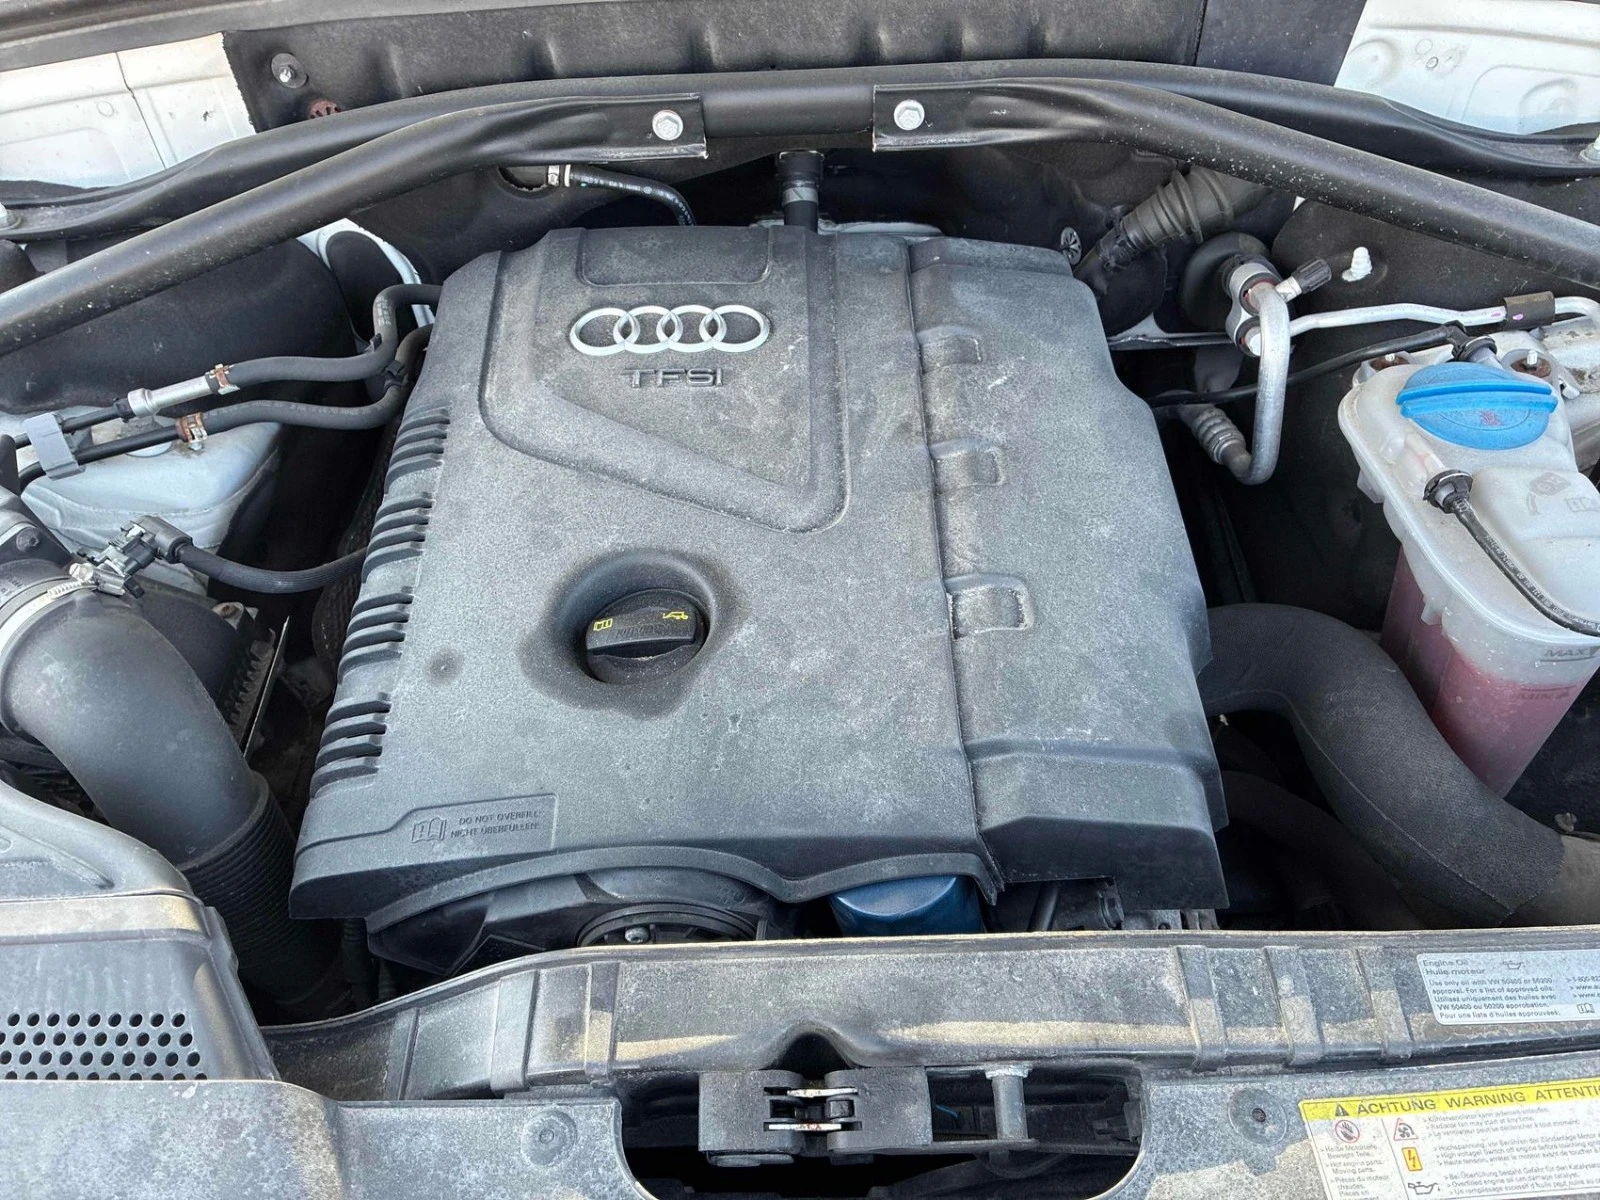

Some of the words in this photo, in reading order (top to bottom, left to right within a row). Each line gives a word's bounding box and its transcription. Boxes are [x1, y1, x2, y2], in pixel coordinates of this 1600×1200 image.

[620, 368, 723, 388] TFSI
[1545, 649, 1586, 657] MAX
[459, 817, 472, 825] DO
[475, 814, 494, 823] NOT
[450, 828, 479, 838] NICHT
[1423, 960, 1455, 968] Engine
[1445, 979, 1459, 987] only
[1357, 1099, 1436, 1115] ACHTUNG
[1444, 1091, 1526, 1108] WARNING
[1536, 1084, 1600, 1100] ATTENTI
